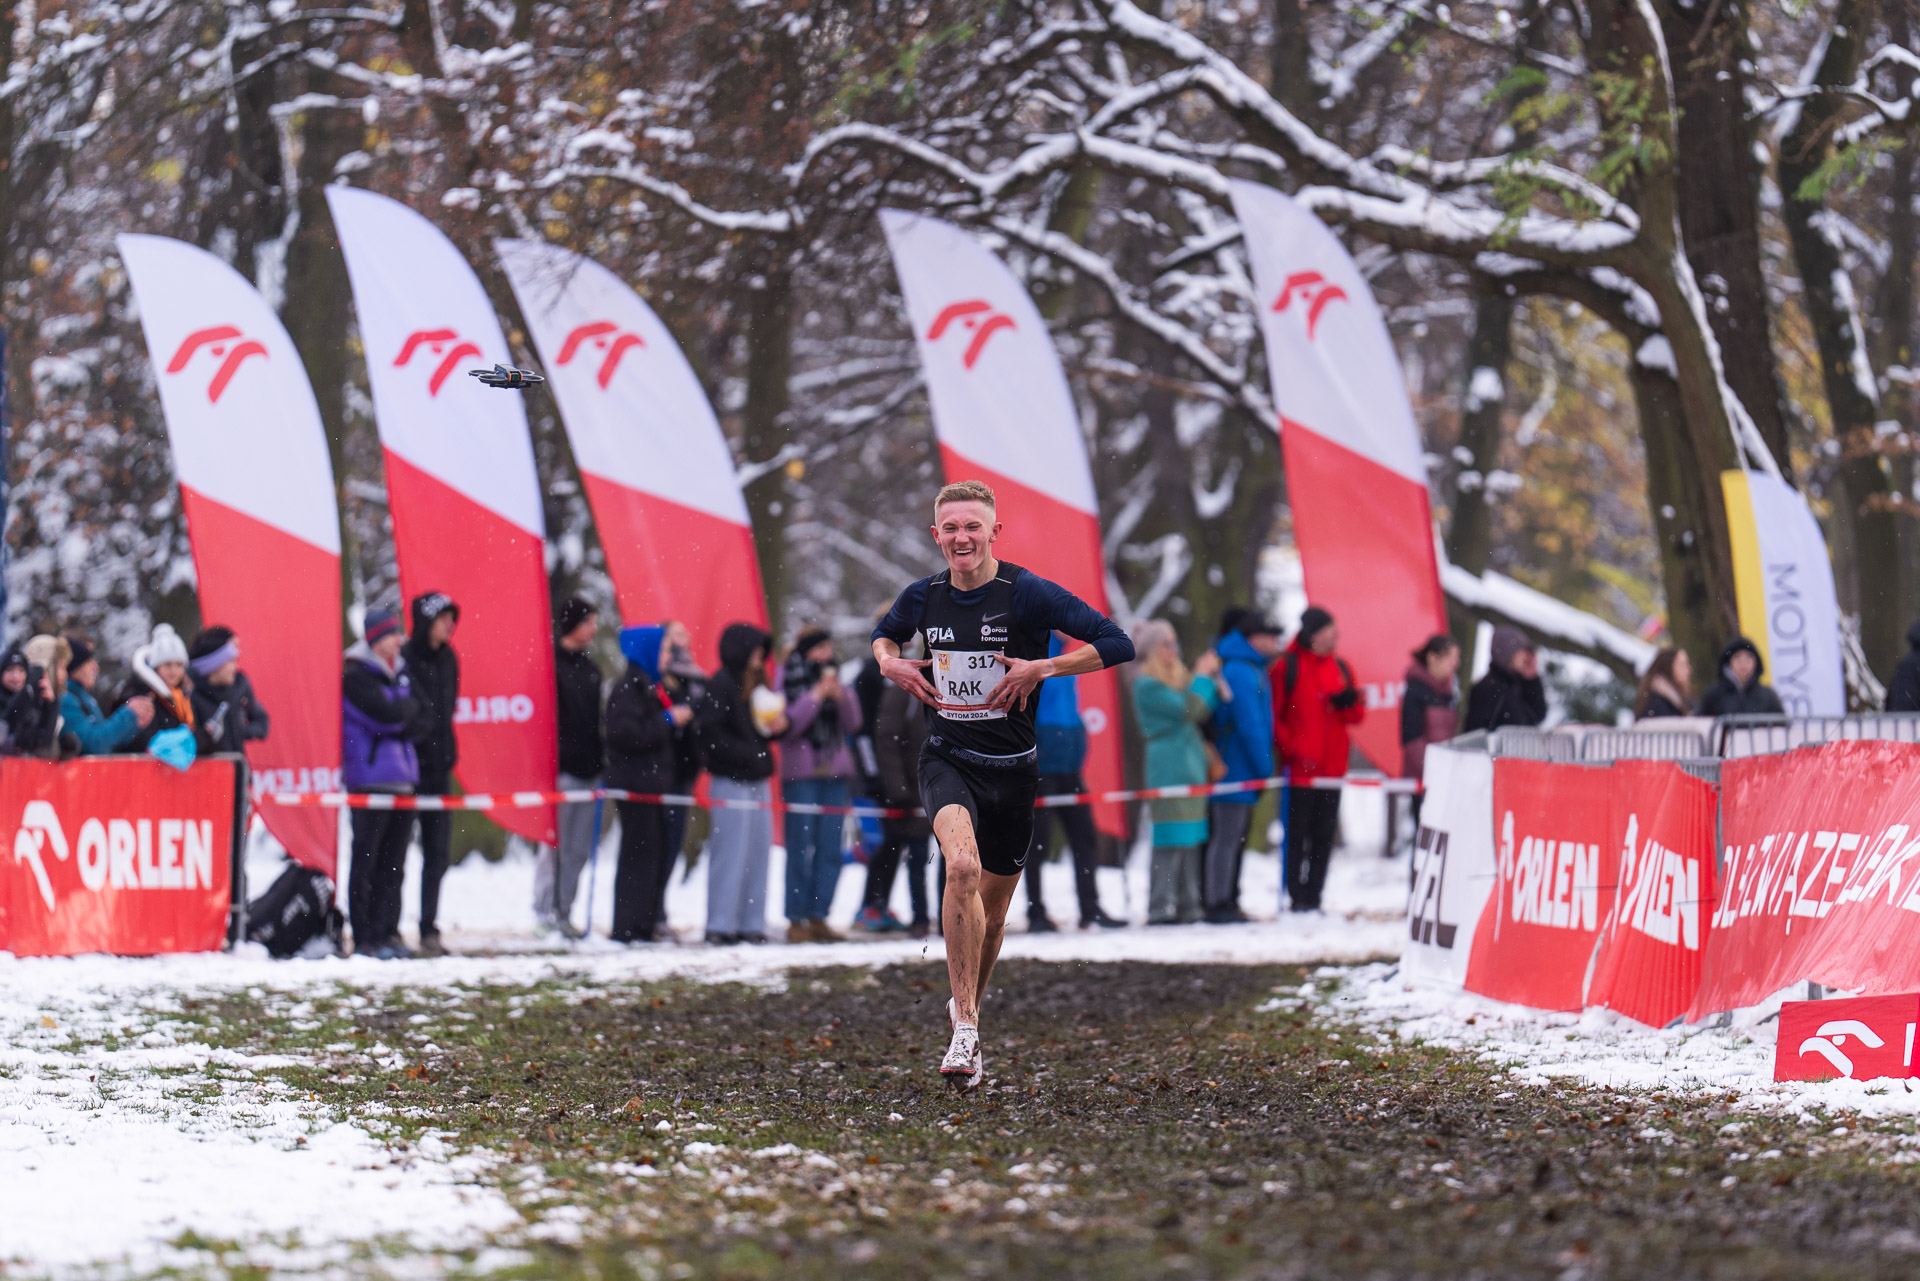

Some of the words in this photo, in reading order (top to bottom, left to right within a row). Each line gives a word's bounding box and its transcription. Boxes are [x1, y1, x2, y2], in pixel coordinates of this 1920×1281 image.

[968, 655, 996, 669] 317
[948, 681, 983, 696] RAK
[77, 817, 213, 892] ORLEN
[1512, 835, 1600, 932] ORLEN
